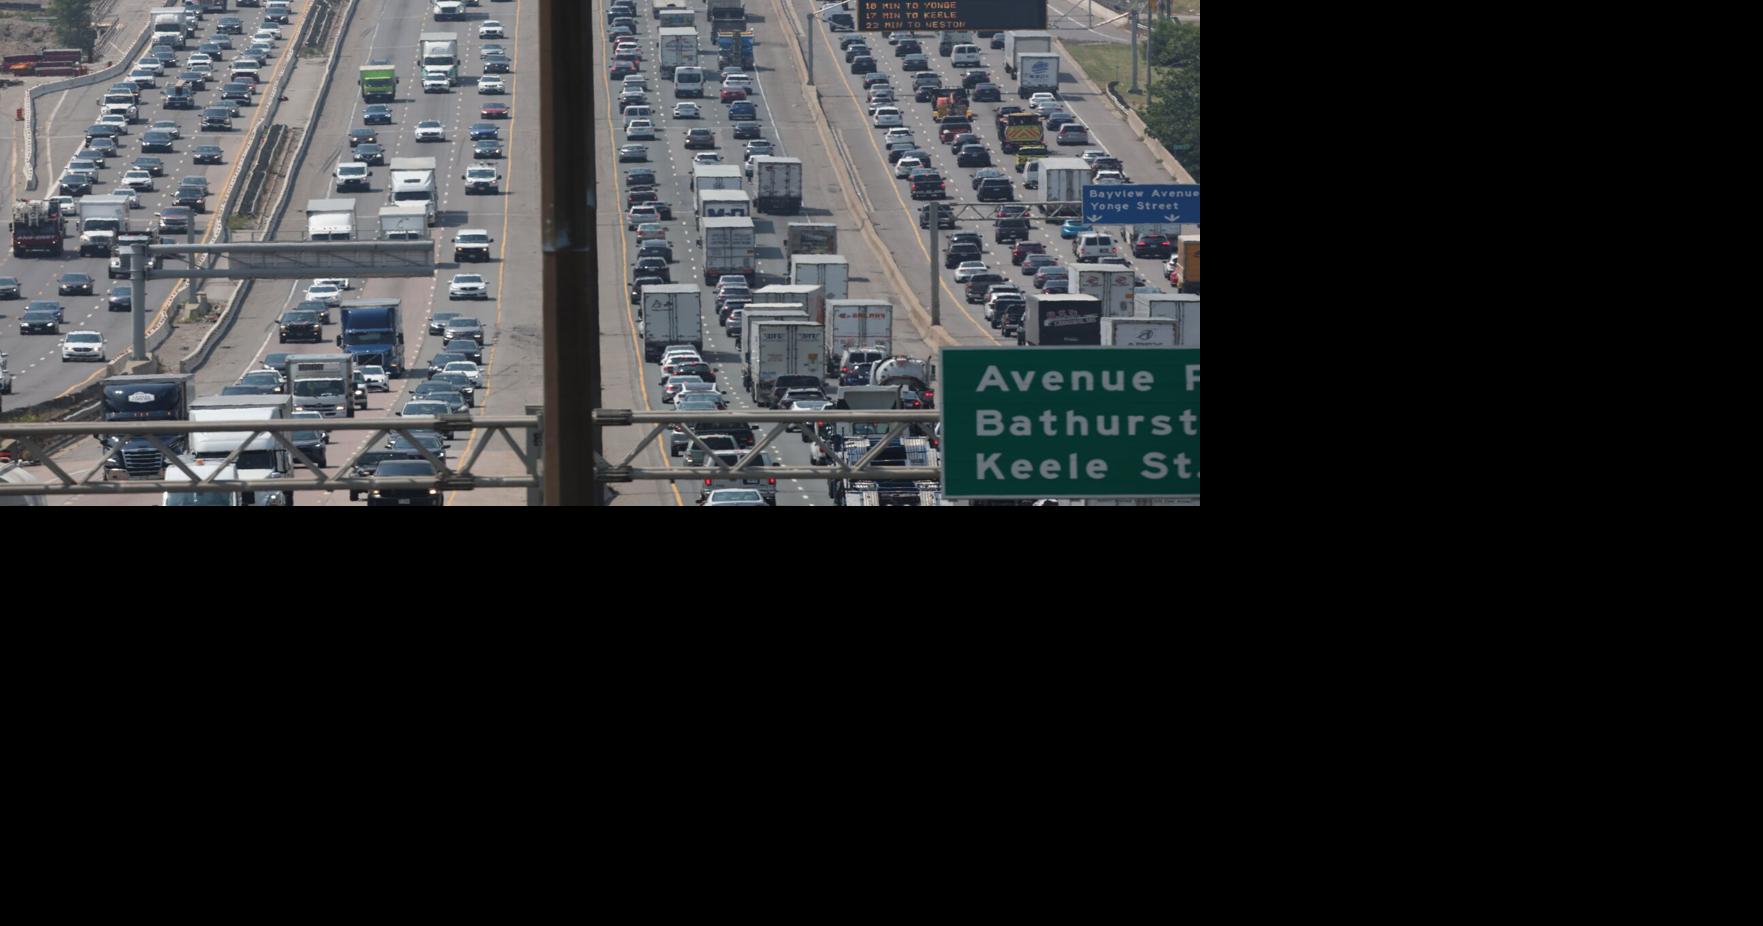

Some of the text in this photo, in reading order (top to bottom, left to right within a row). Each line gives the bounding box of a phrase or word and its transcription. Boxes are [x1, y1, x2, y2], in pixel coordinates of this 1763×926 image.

[882, 1, 900, 10] MIN
[906, 1, 920, 10] TO
[924, 1, 958, 10] YONGE
[865, 11, 958, 19] 17 MIN TO KEELE
[884, 21, 902, 29] MIN
[907, 21, 921, 29] TO
[1089, 189, 1200, 200] Bayview Avenue
[1090, 201, 1179, 212] Yonge Street
[975, 364, 1155, 392] Avenue
[975, 408, 1198, 437] Bathurst
[975, 452, 1109, 480] Keele
